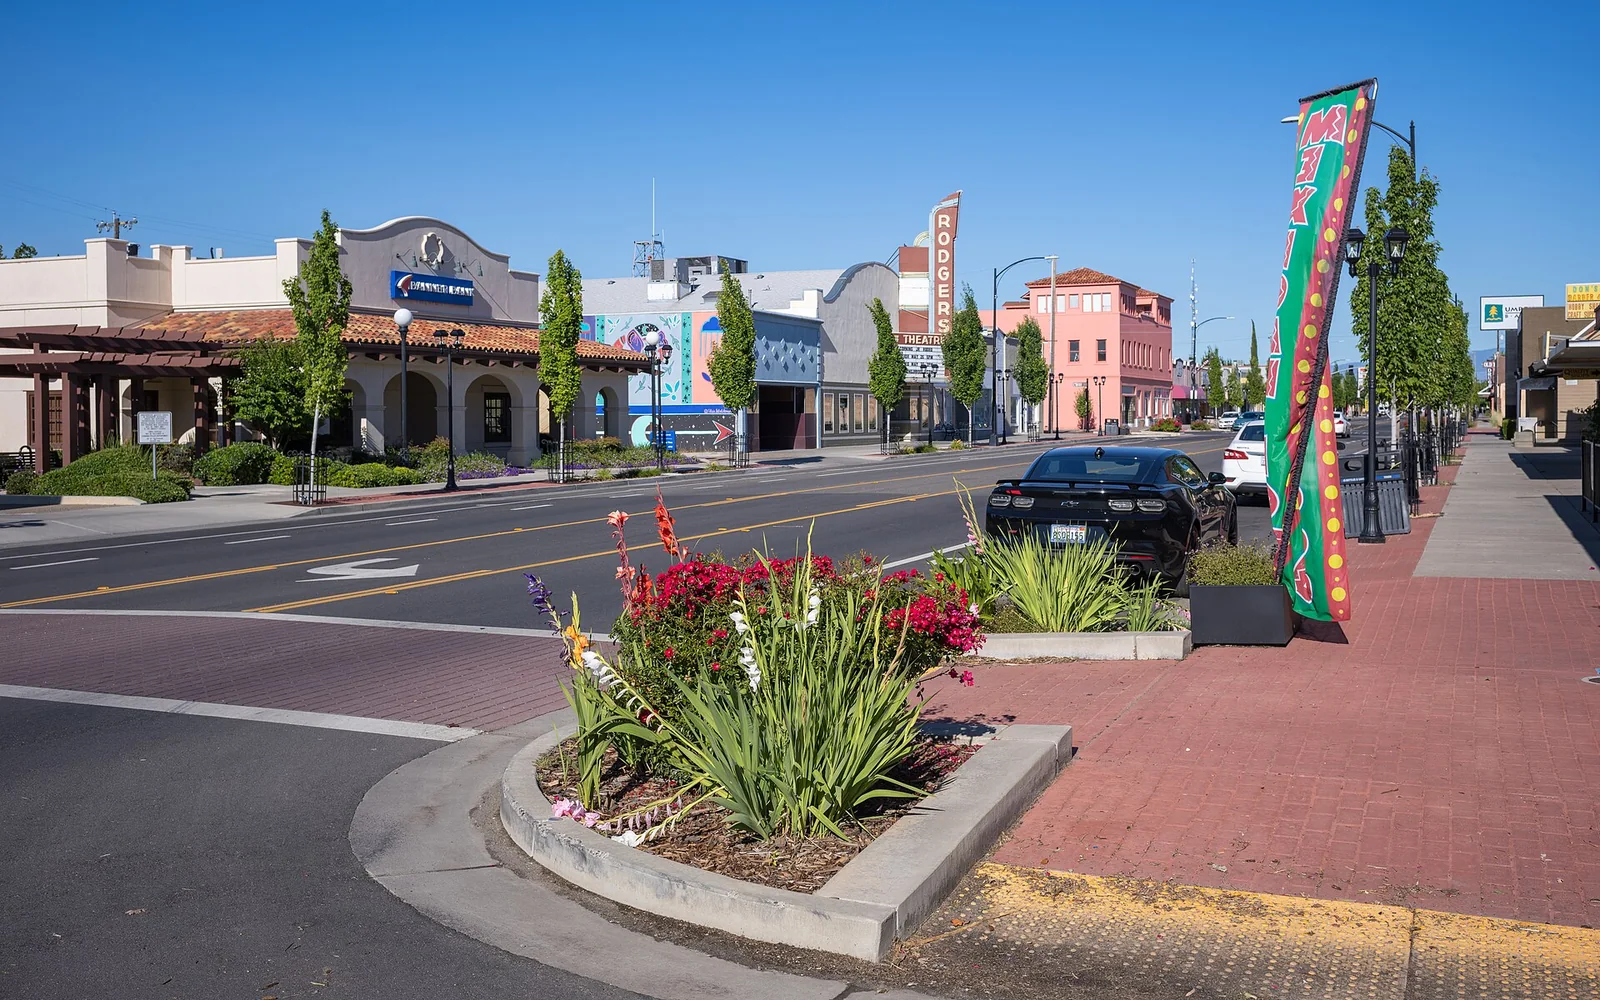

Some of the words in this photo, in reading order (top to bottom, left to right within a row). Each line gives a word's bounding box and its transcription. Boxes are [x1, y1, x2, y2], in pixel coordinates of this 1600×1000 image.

[410, 281, 448, 294] BANNER
[449, 285, 475, 297] BANK
[937, 214, 950, 333] RODGERS
